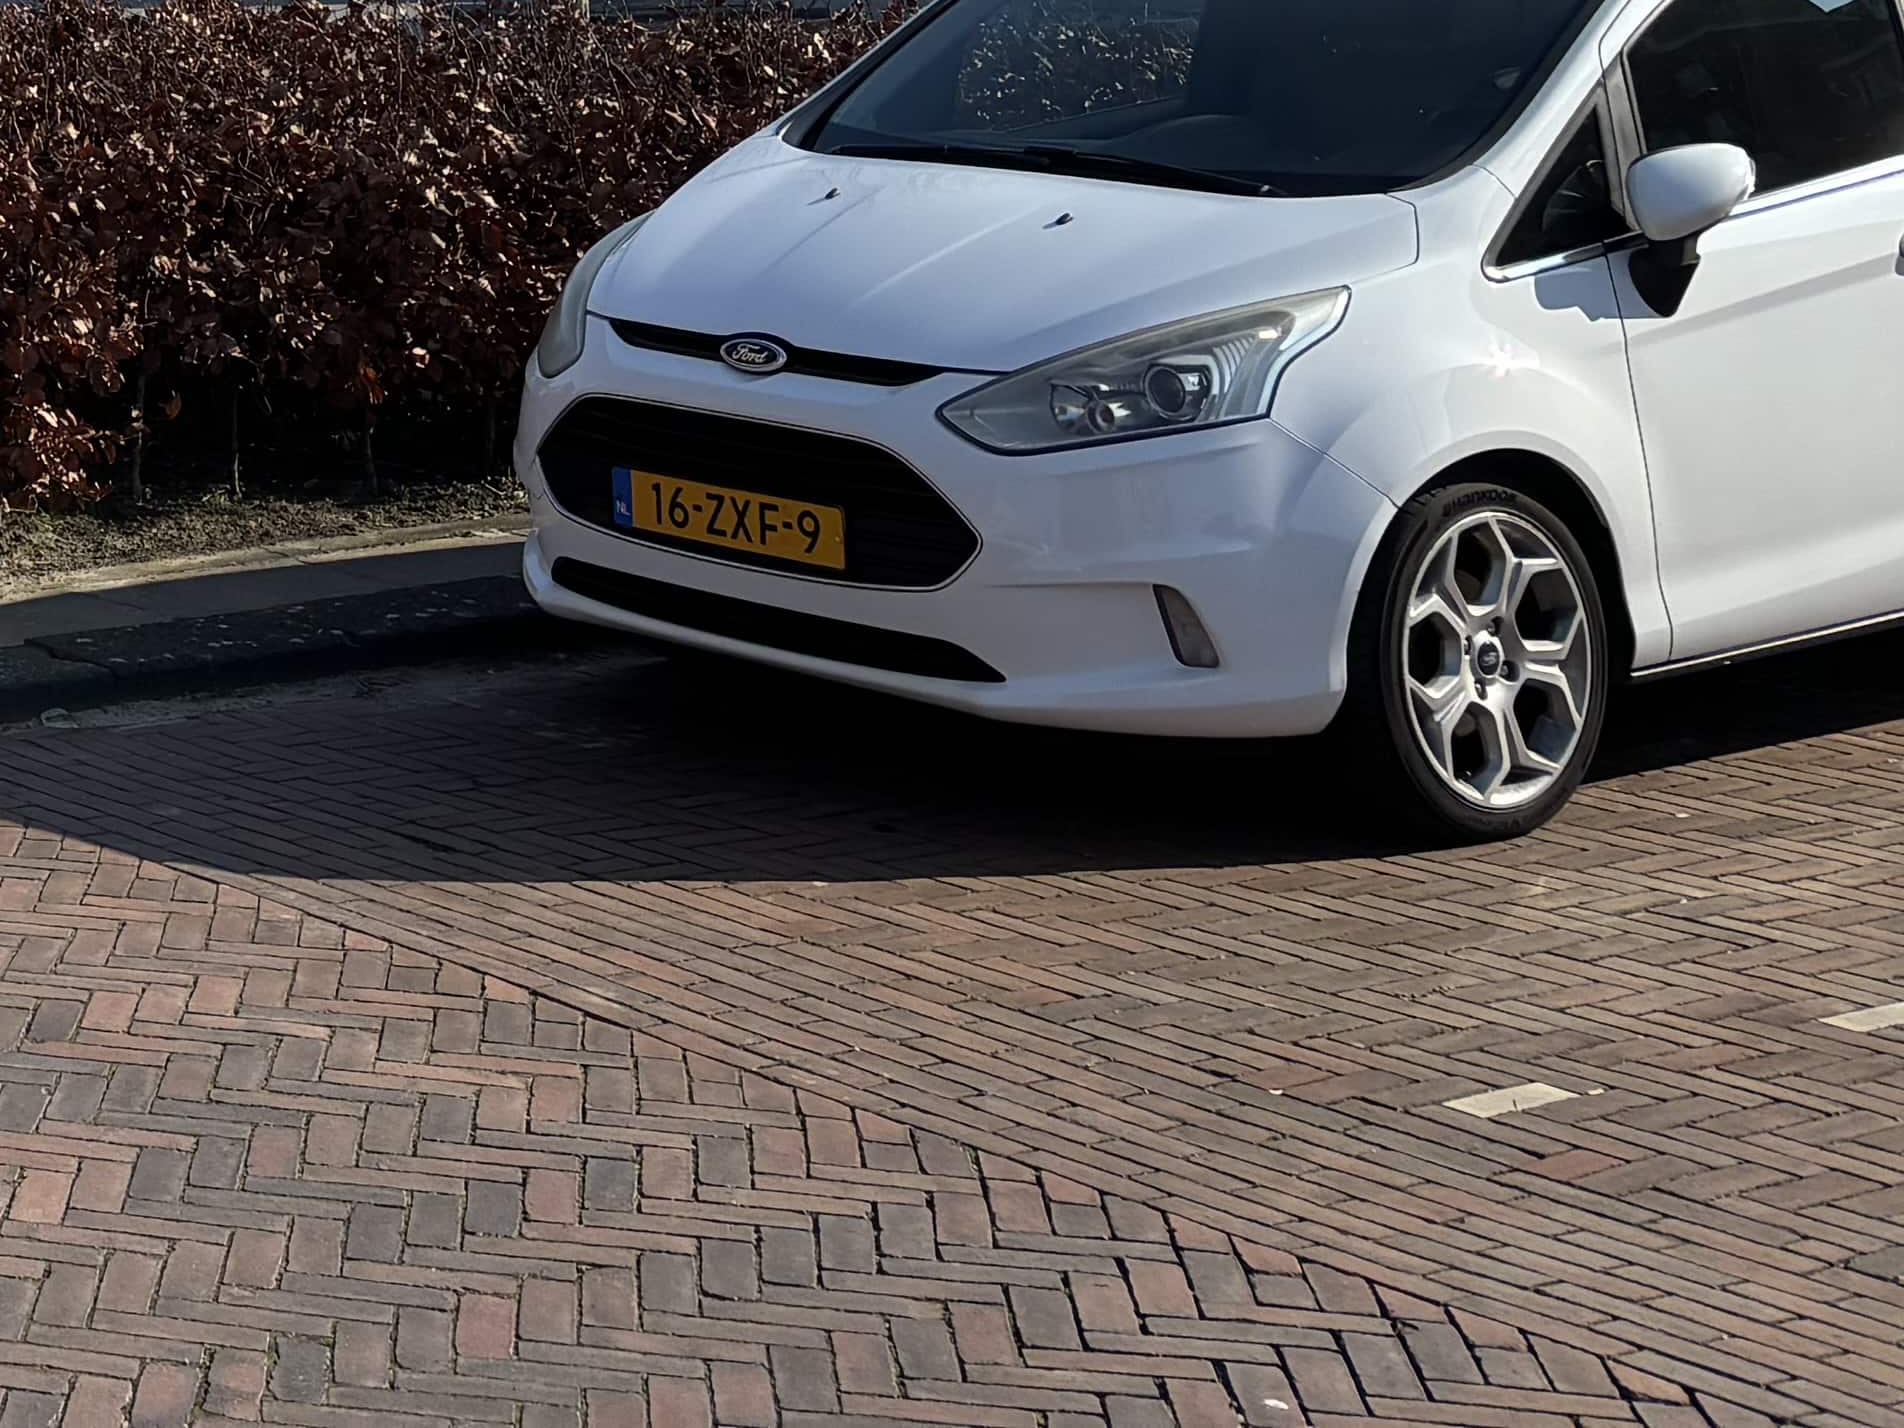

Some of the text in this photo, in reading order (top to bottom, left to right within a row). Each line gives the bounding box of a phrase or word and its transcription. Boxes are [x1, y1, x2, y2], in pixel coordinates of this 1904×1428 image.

[732, 343, 769, 363] Ford
[616, 499, 631, 516] NL
[651, 482, 821, 554] 16-ZXF-9
